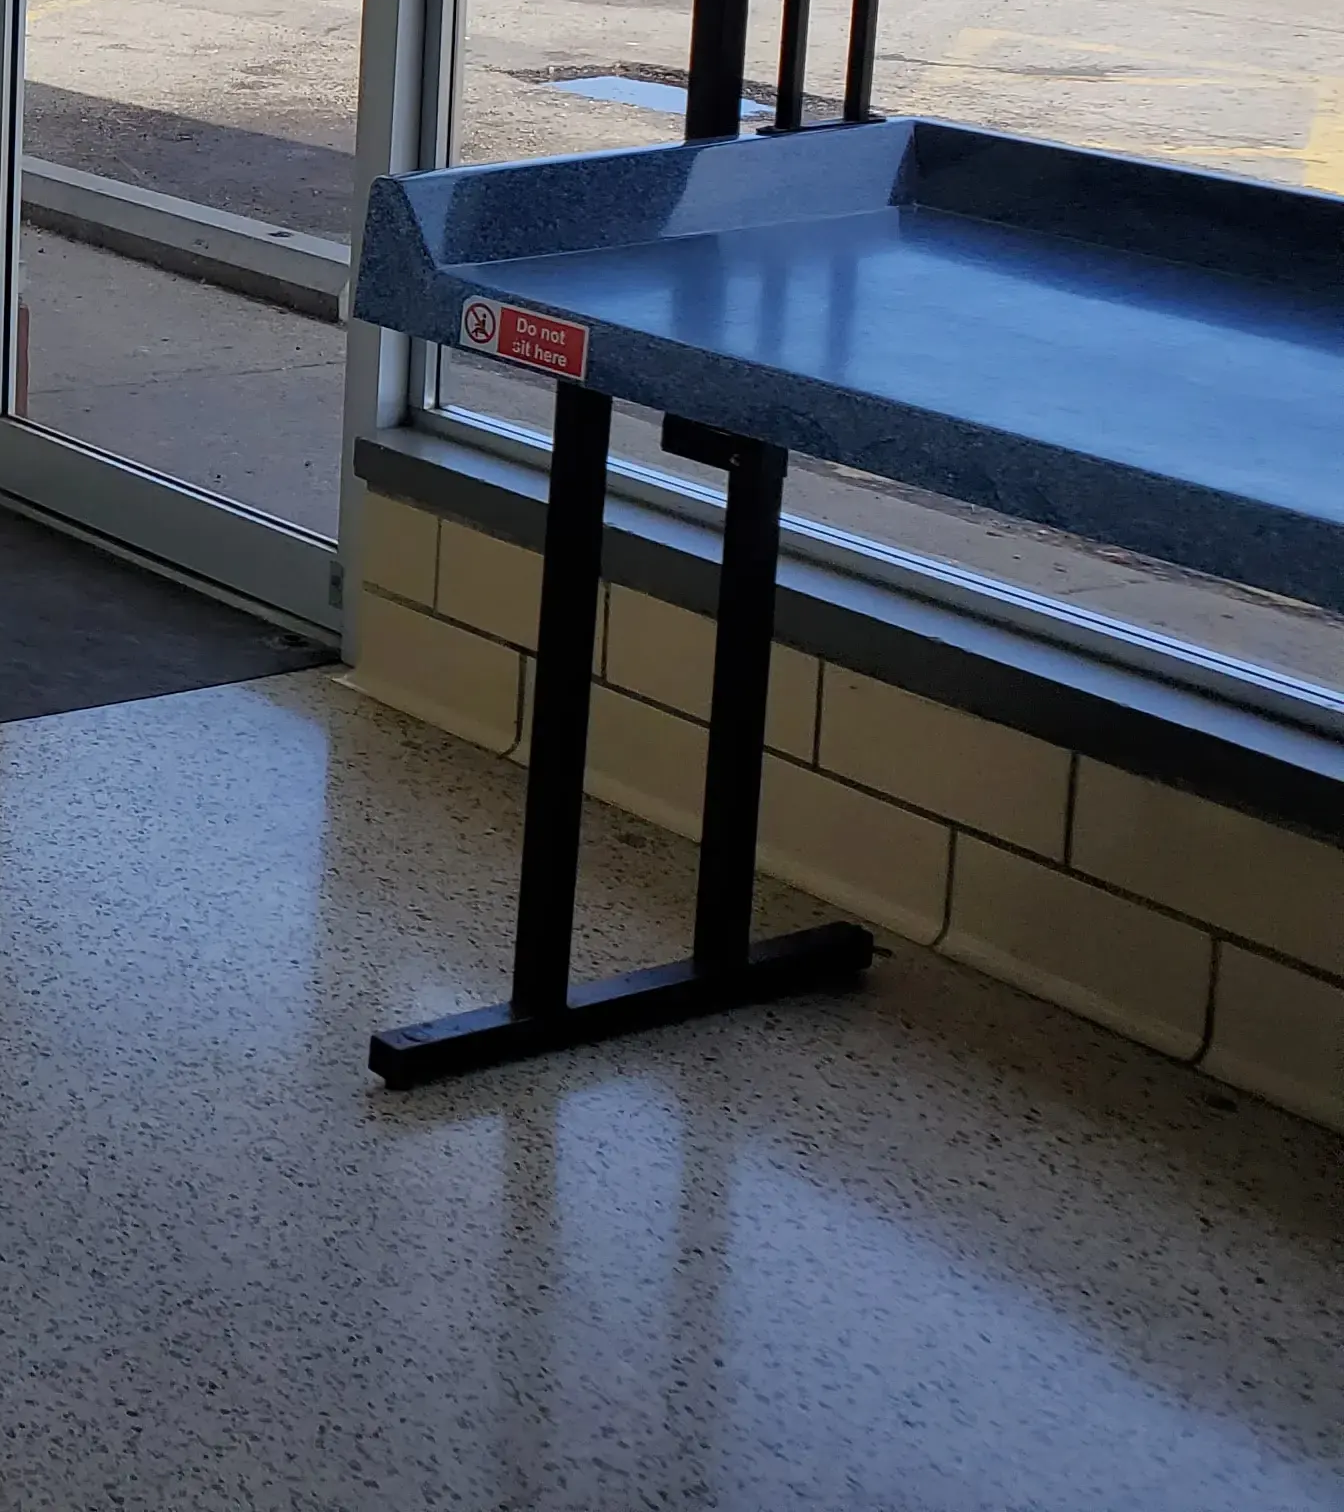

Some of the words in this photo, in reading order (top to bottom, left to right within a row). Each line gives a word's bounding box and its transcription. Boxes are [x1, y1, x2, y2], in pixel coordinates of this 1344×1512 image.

[516, 317, 537, 337] Do
[541, 328, 566, 346] not
[511, 338, 531, 358] sit
[534, 343, 567, 368] here
